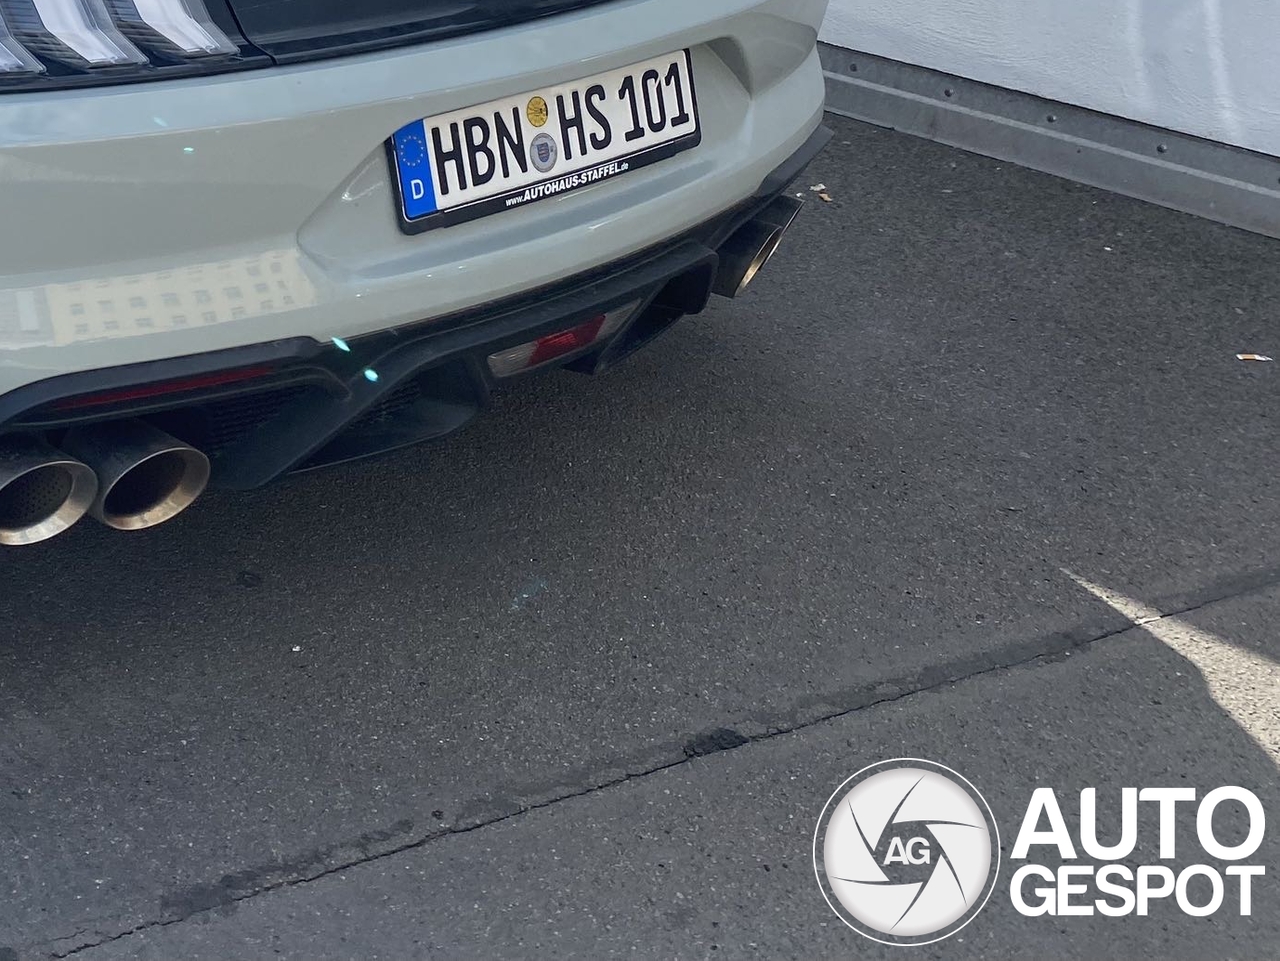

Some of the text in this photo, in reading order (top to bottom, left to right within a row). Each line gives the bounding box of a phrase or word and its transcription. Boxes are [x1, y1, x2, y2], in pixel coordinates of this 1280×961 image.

[410, 62, 690, 200] D HBN HS 101
[505, 161, 629, 207] www.AUTOHAUS-STAFFEL.de
